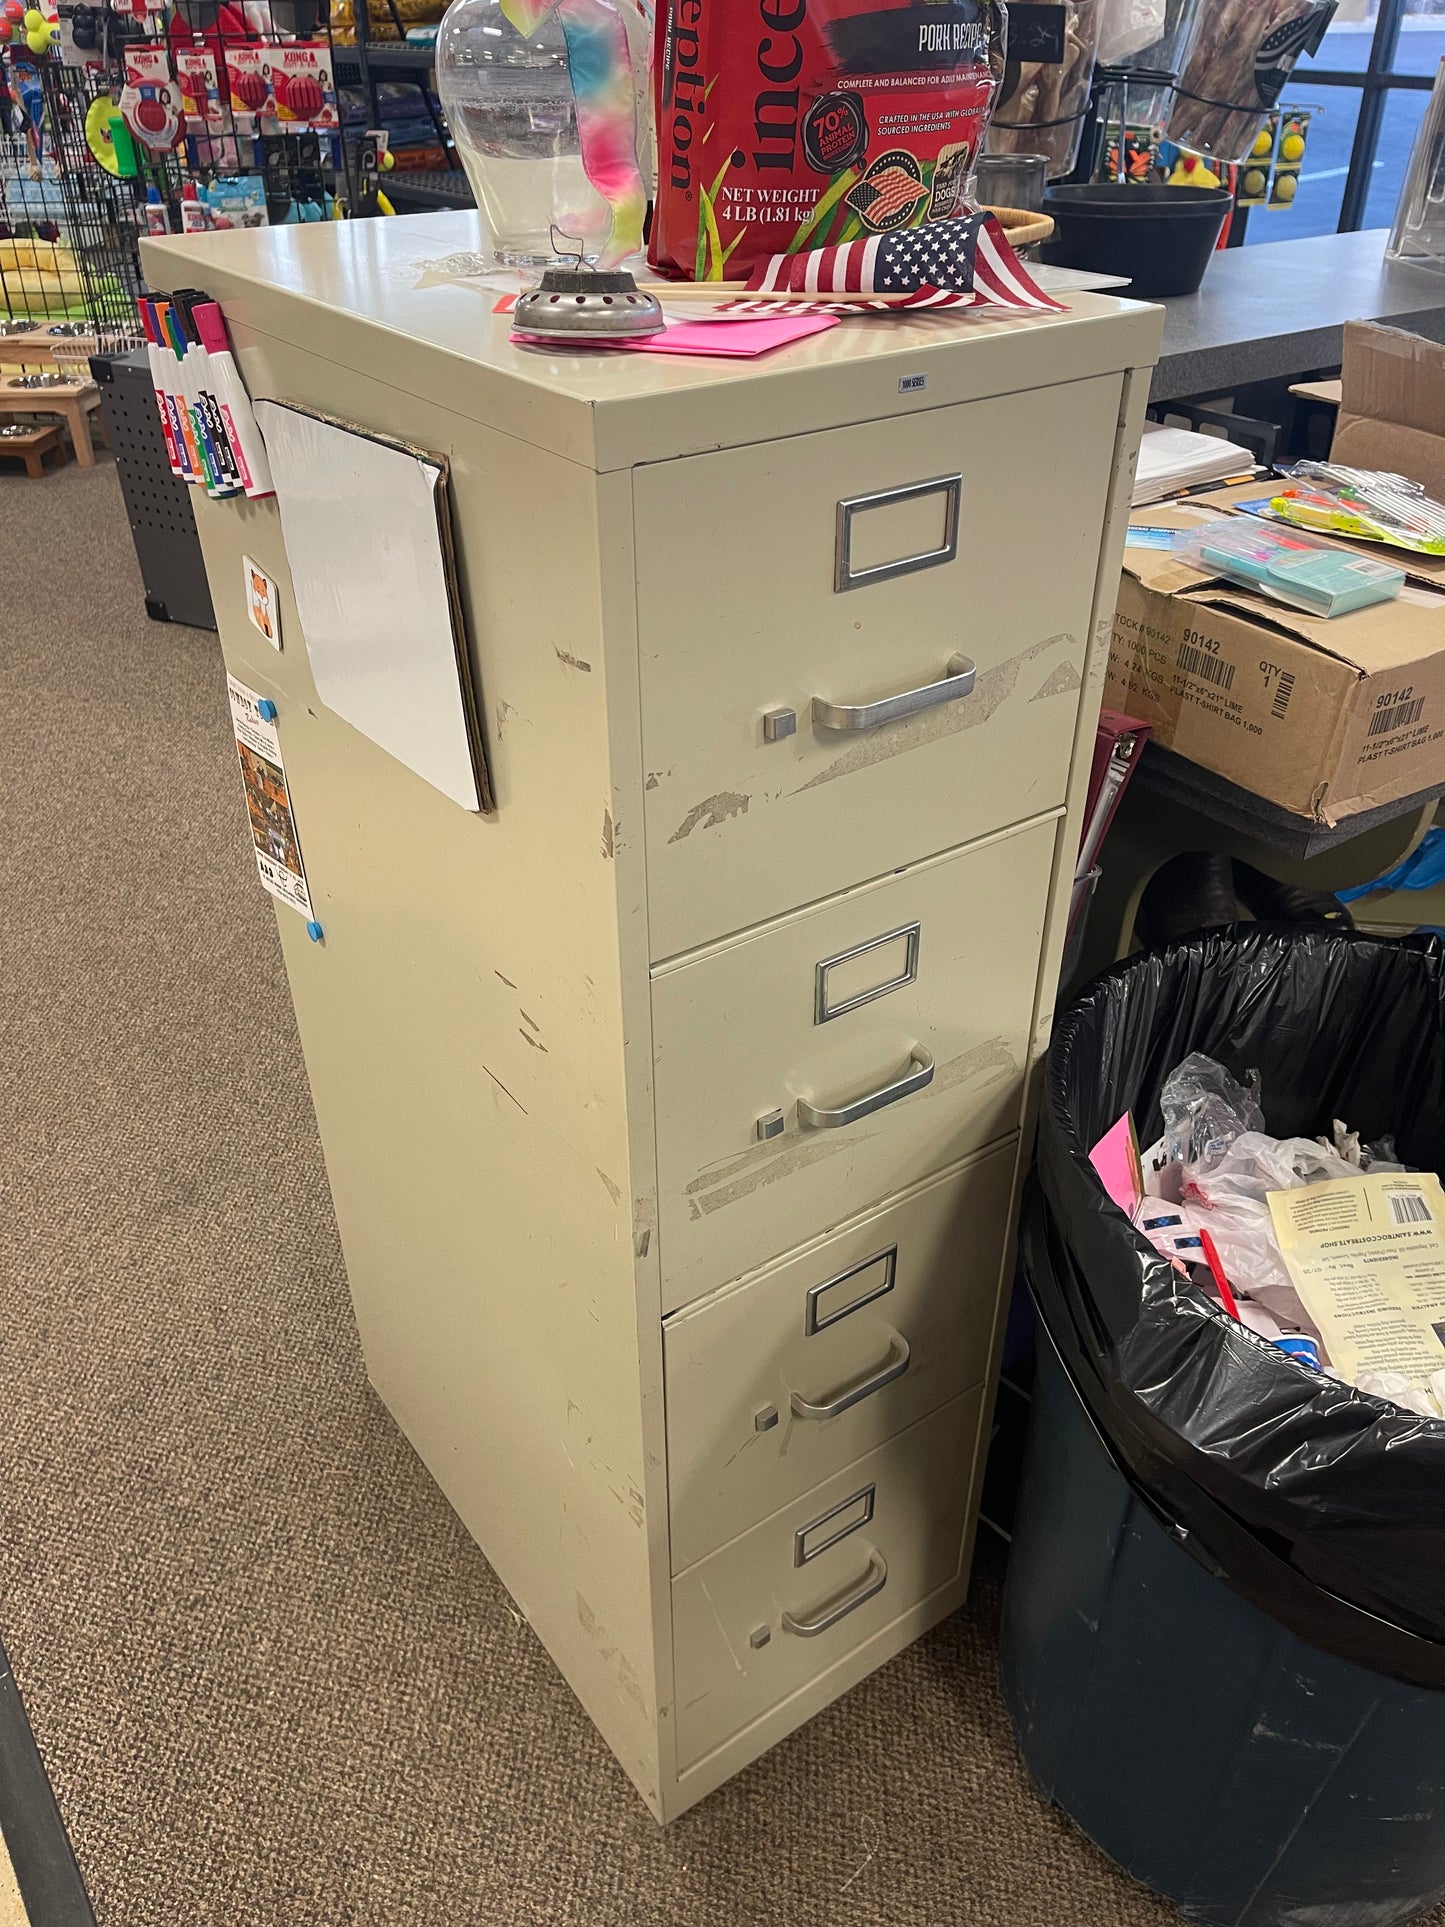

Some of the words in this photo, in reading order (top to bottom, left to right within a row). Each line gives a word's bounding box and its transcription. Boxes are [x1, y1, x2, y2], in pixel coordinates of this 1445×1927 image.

[919, 23, 950, 52] PORK
[952, 22, 983, 51] RECIPE
[133, 54, 153, 64] KONG
[284, 51, 308, 62] KONG
[837, 79, 873, 89] COMPLETE
[874, 78, 890, 87] AND
[891, 77, 926, 87] BALANCED
[927, 76, 940, 84] FOR
[812, 105, 849, 139] 70%
[878, 114, 909, 124] CRAFTED
[910, 114, 918, 122] IN
[919, 112, 931, 121] THE
[932, 111, 944, 120] USA
[945, 110, 960, 119] WITH
[820, 122, 854, 148] ANIMAL
[877, 126, 909, 136] SOURCED
[911, 121, 951, 133] INGREDIENTS
[821, 131, 856, 156] PROTEIN
[722, 187, 754, 202] NET
[757, 188, 820, 203] WEIGHT
[935, 186, 957, 202] DOGS
[722, 206, 732, 220] 4
[735, 206, 757, 222] LB
[759, 207, 791, 225] (1.81
[794, 206, 816, 225] kg)
[1115, 613, 1139, 632] TOCK
[1146, 627, 1171, 645] 90142
[1112, 633, 1126, 646] TY:
[1127, 639, 1146, 656] 1000
[1148, 649, 1167, 665] PCS
[1183, 628, 1221, 655] 90142
[1109, 652, 1121, 664] W:
[1107, 671, 1118, 683] W:
[1259, 661, 1282, 678] QTY
[1264, 676, 1269, 687] 1
[1376, 686, 1413, 709] 90142
[1170, 686, 1194, 703] PLAST
[1195, 697, 1223, 717] T-SHIRT
[1224, 711, 1242, 726] BAG
[1224, 700, 1244, 714] LIME
[1413, 724, 1430, 737] LIME
[1357, 751, 1384, 765] PLAST
[1384, 741, 1411, 756] T-SHIRT
[1411, 736, 1427, 748] BAG
